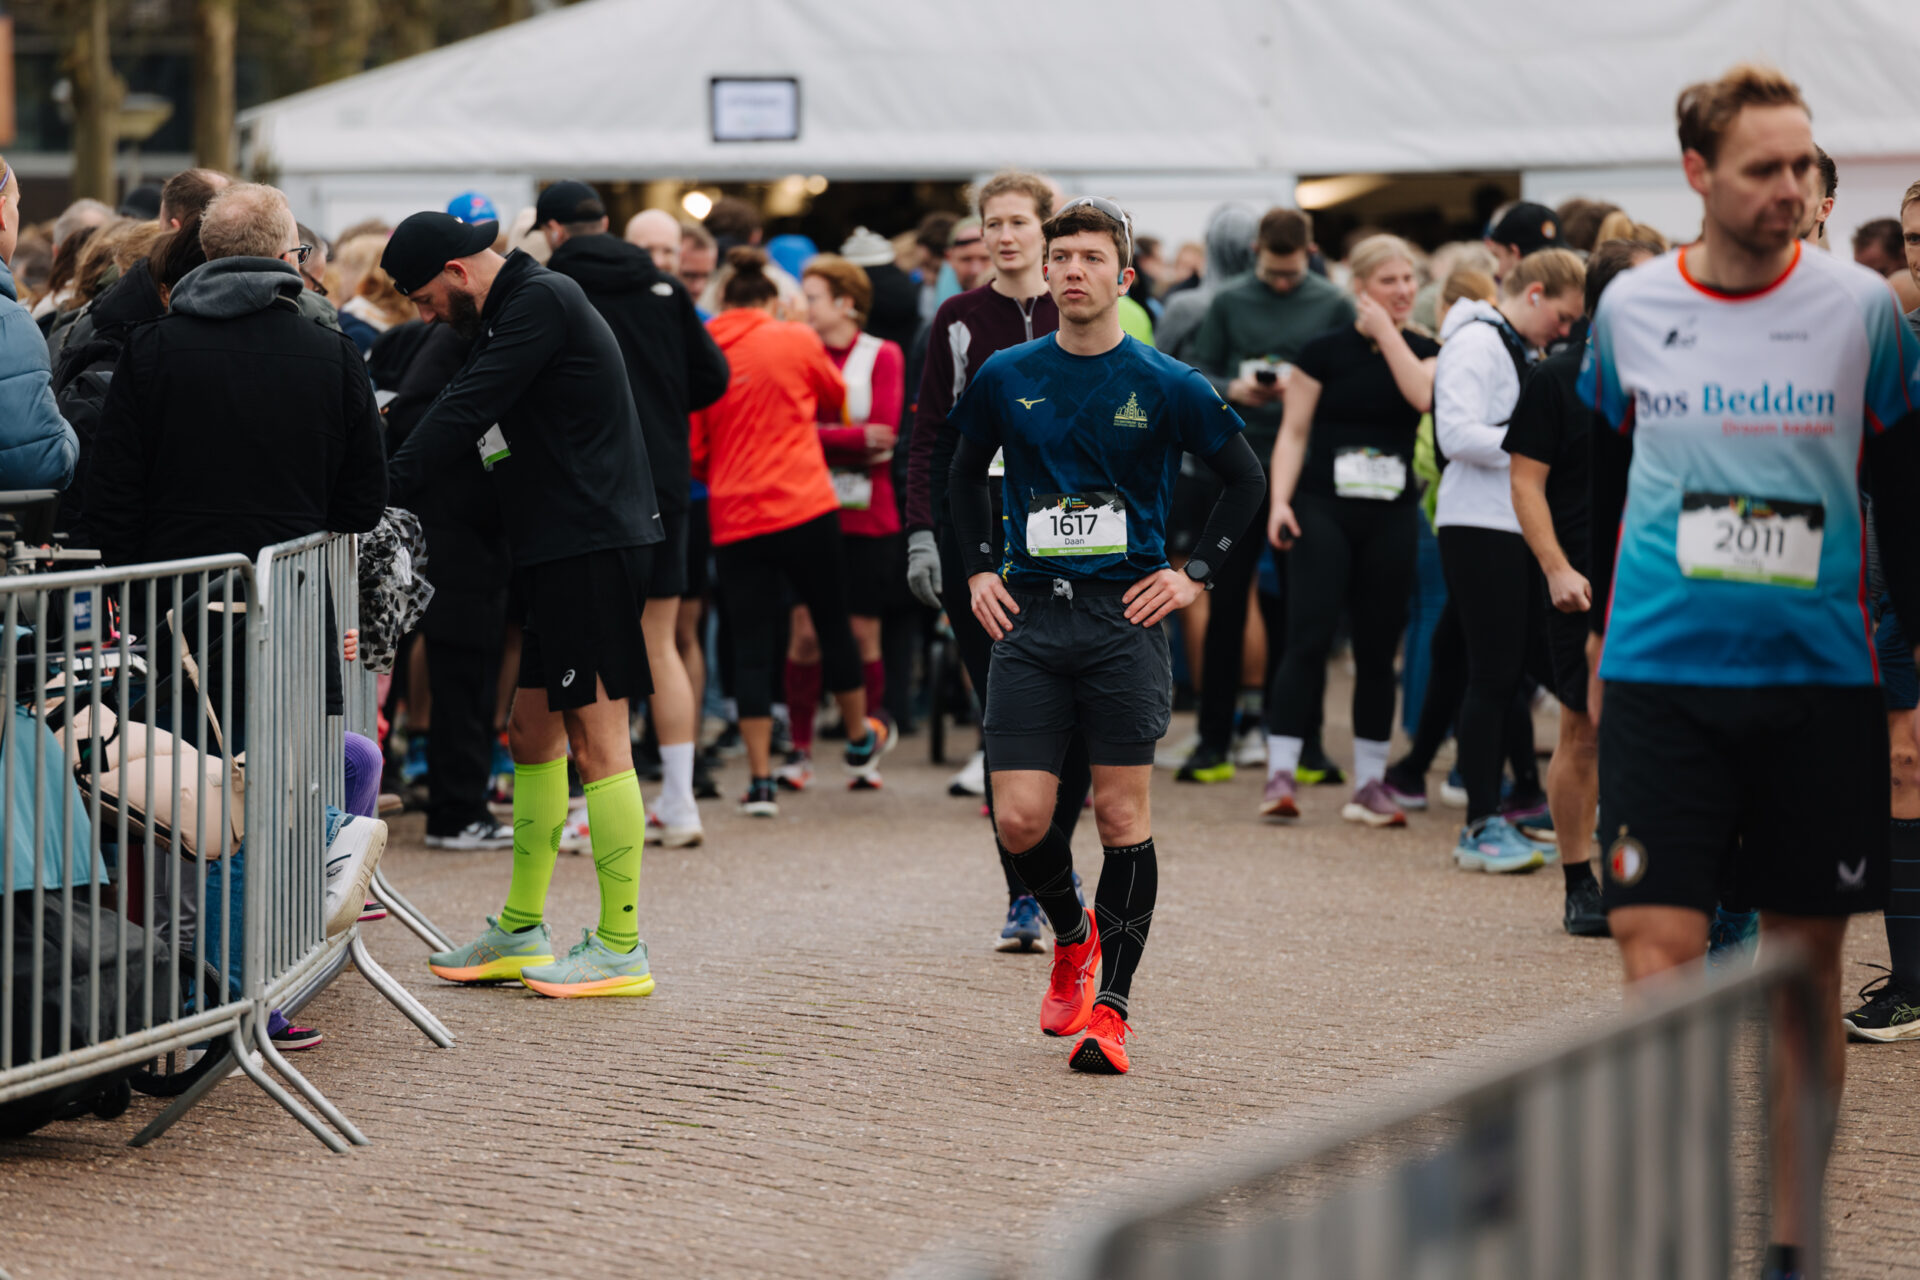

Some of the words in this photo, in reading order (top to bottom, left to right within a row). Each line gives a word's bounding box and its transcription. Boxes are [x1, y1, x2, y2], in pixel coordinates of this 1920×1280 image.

[1703, 381, 1835, 415] Bedden
[1049, 514, 1098, 536] 1617
[1714, 520, 1785, 557] 2011
